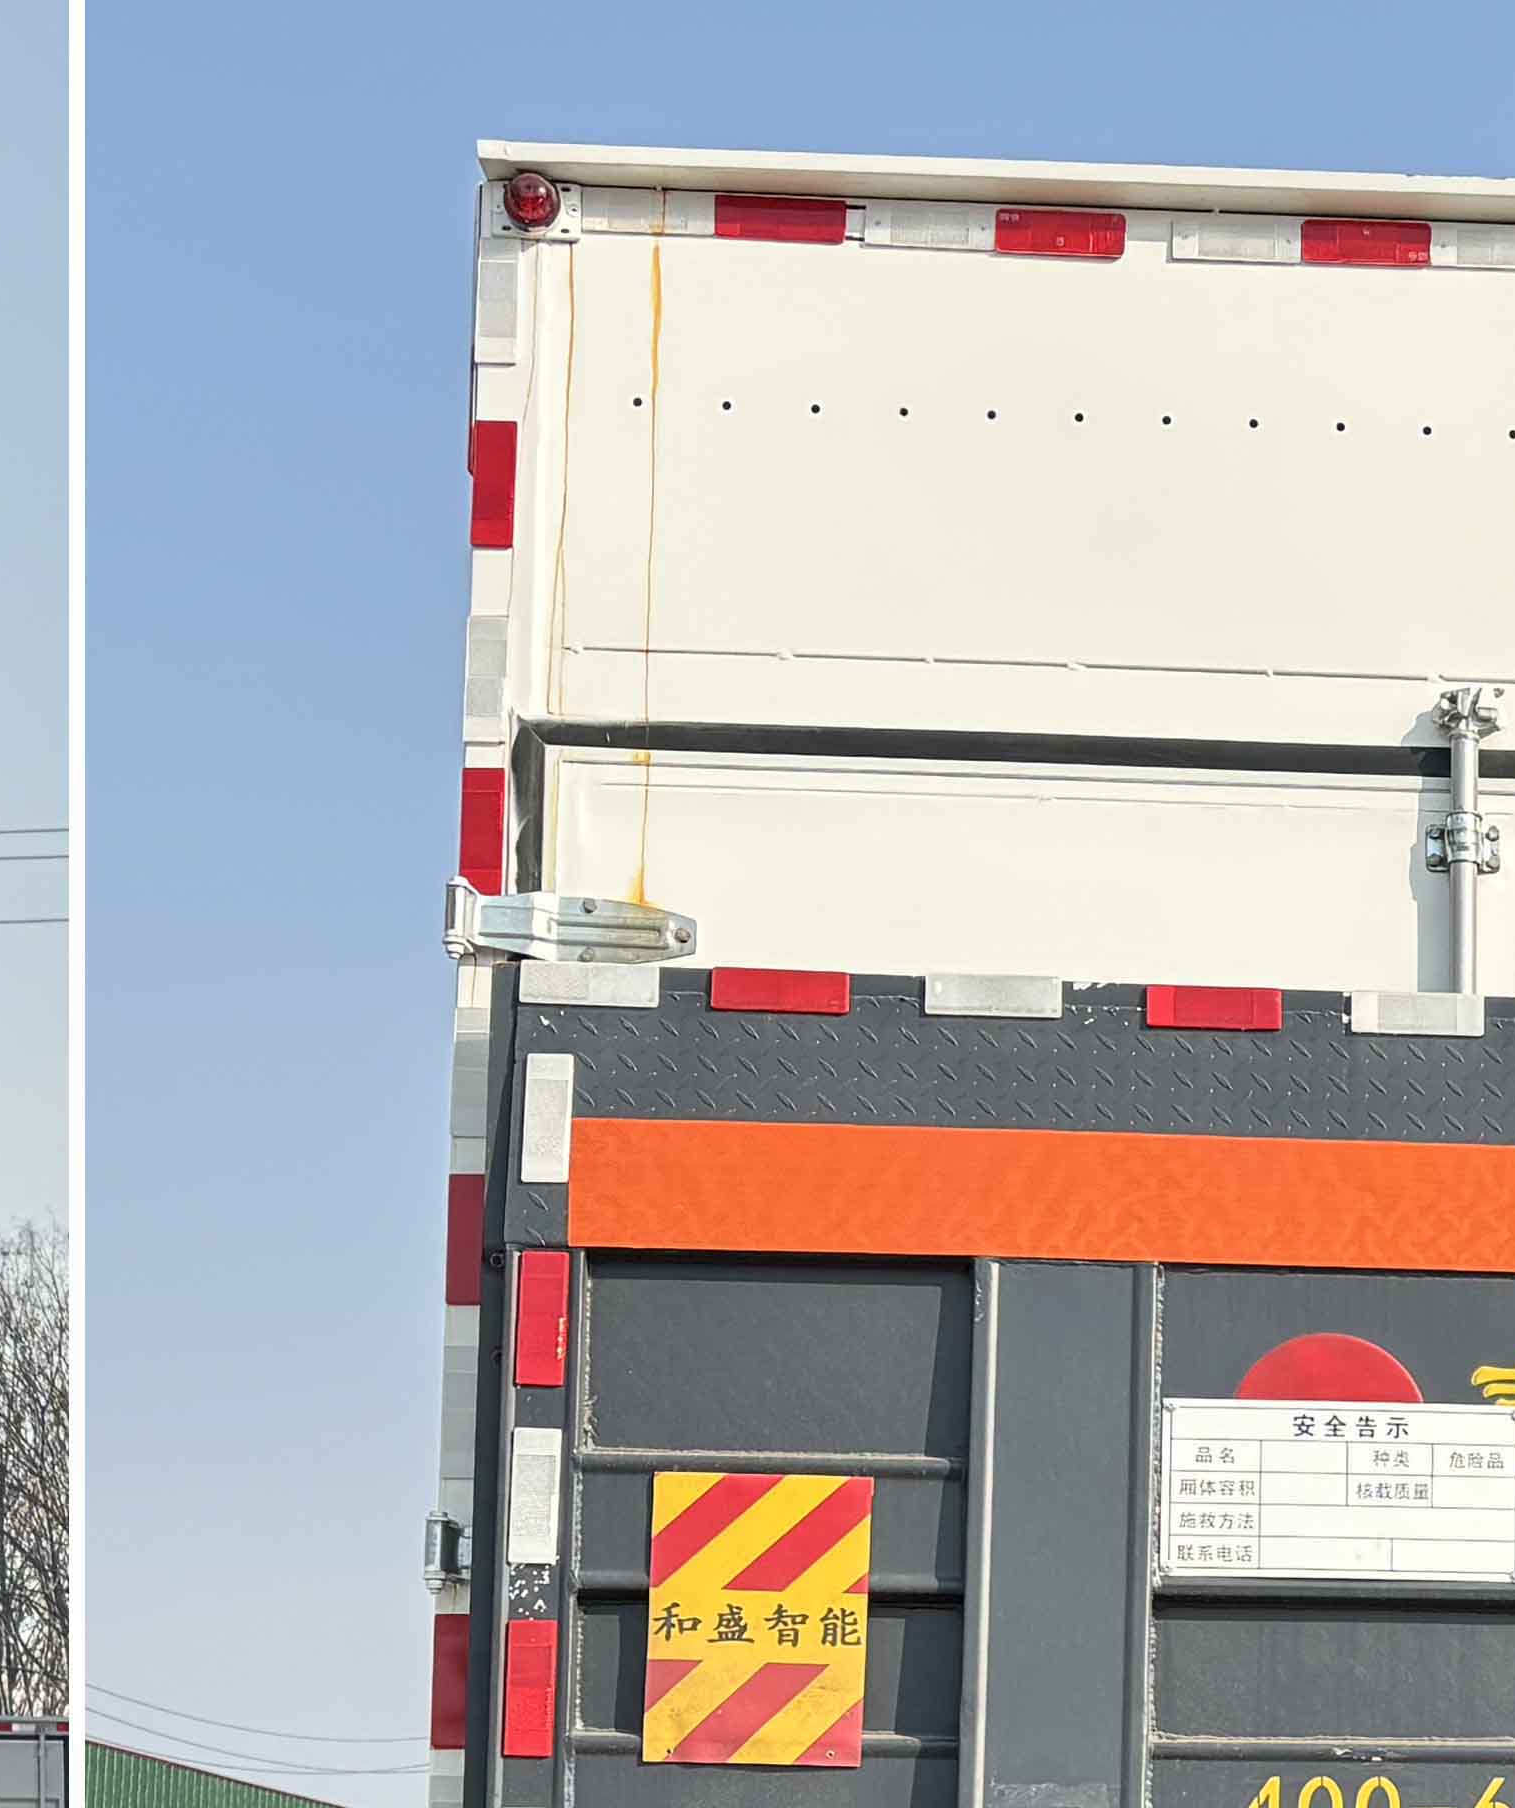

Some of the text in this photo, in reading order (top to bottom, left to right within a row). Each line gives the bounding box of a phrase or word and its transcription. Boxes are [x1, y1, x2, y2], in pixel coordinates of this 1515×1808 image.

[1292, 1414, 1410, 1440] 安全告示
[1194, 1446, 1237, 1465] 品名
[1371, 1449, 1411, 1468] 种类
[1448, 1451, 1506, 1470] 危险品
[1178, 1478, 1257, 1498] 厢体容积
[1355, 1482, 1430, 1501] 核载质量
[1178, 1511, 1256, 1531] 施救方法
[1176, 1544, 1254, 1563] 联系电话
[652, 1601, 864, 1650] 和盛智能
